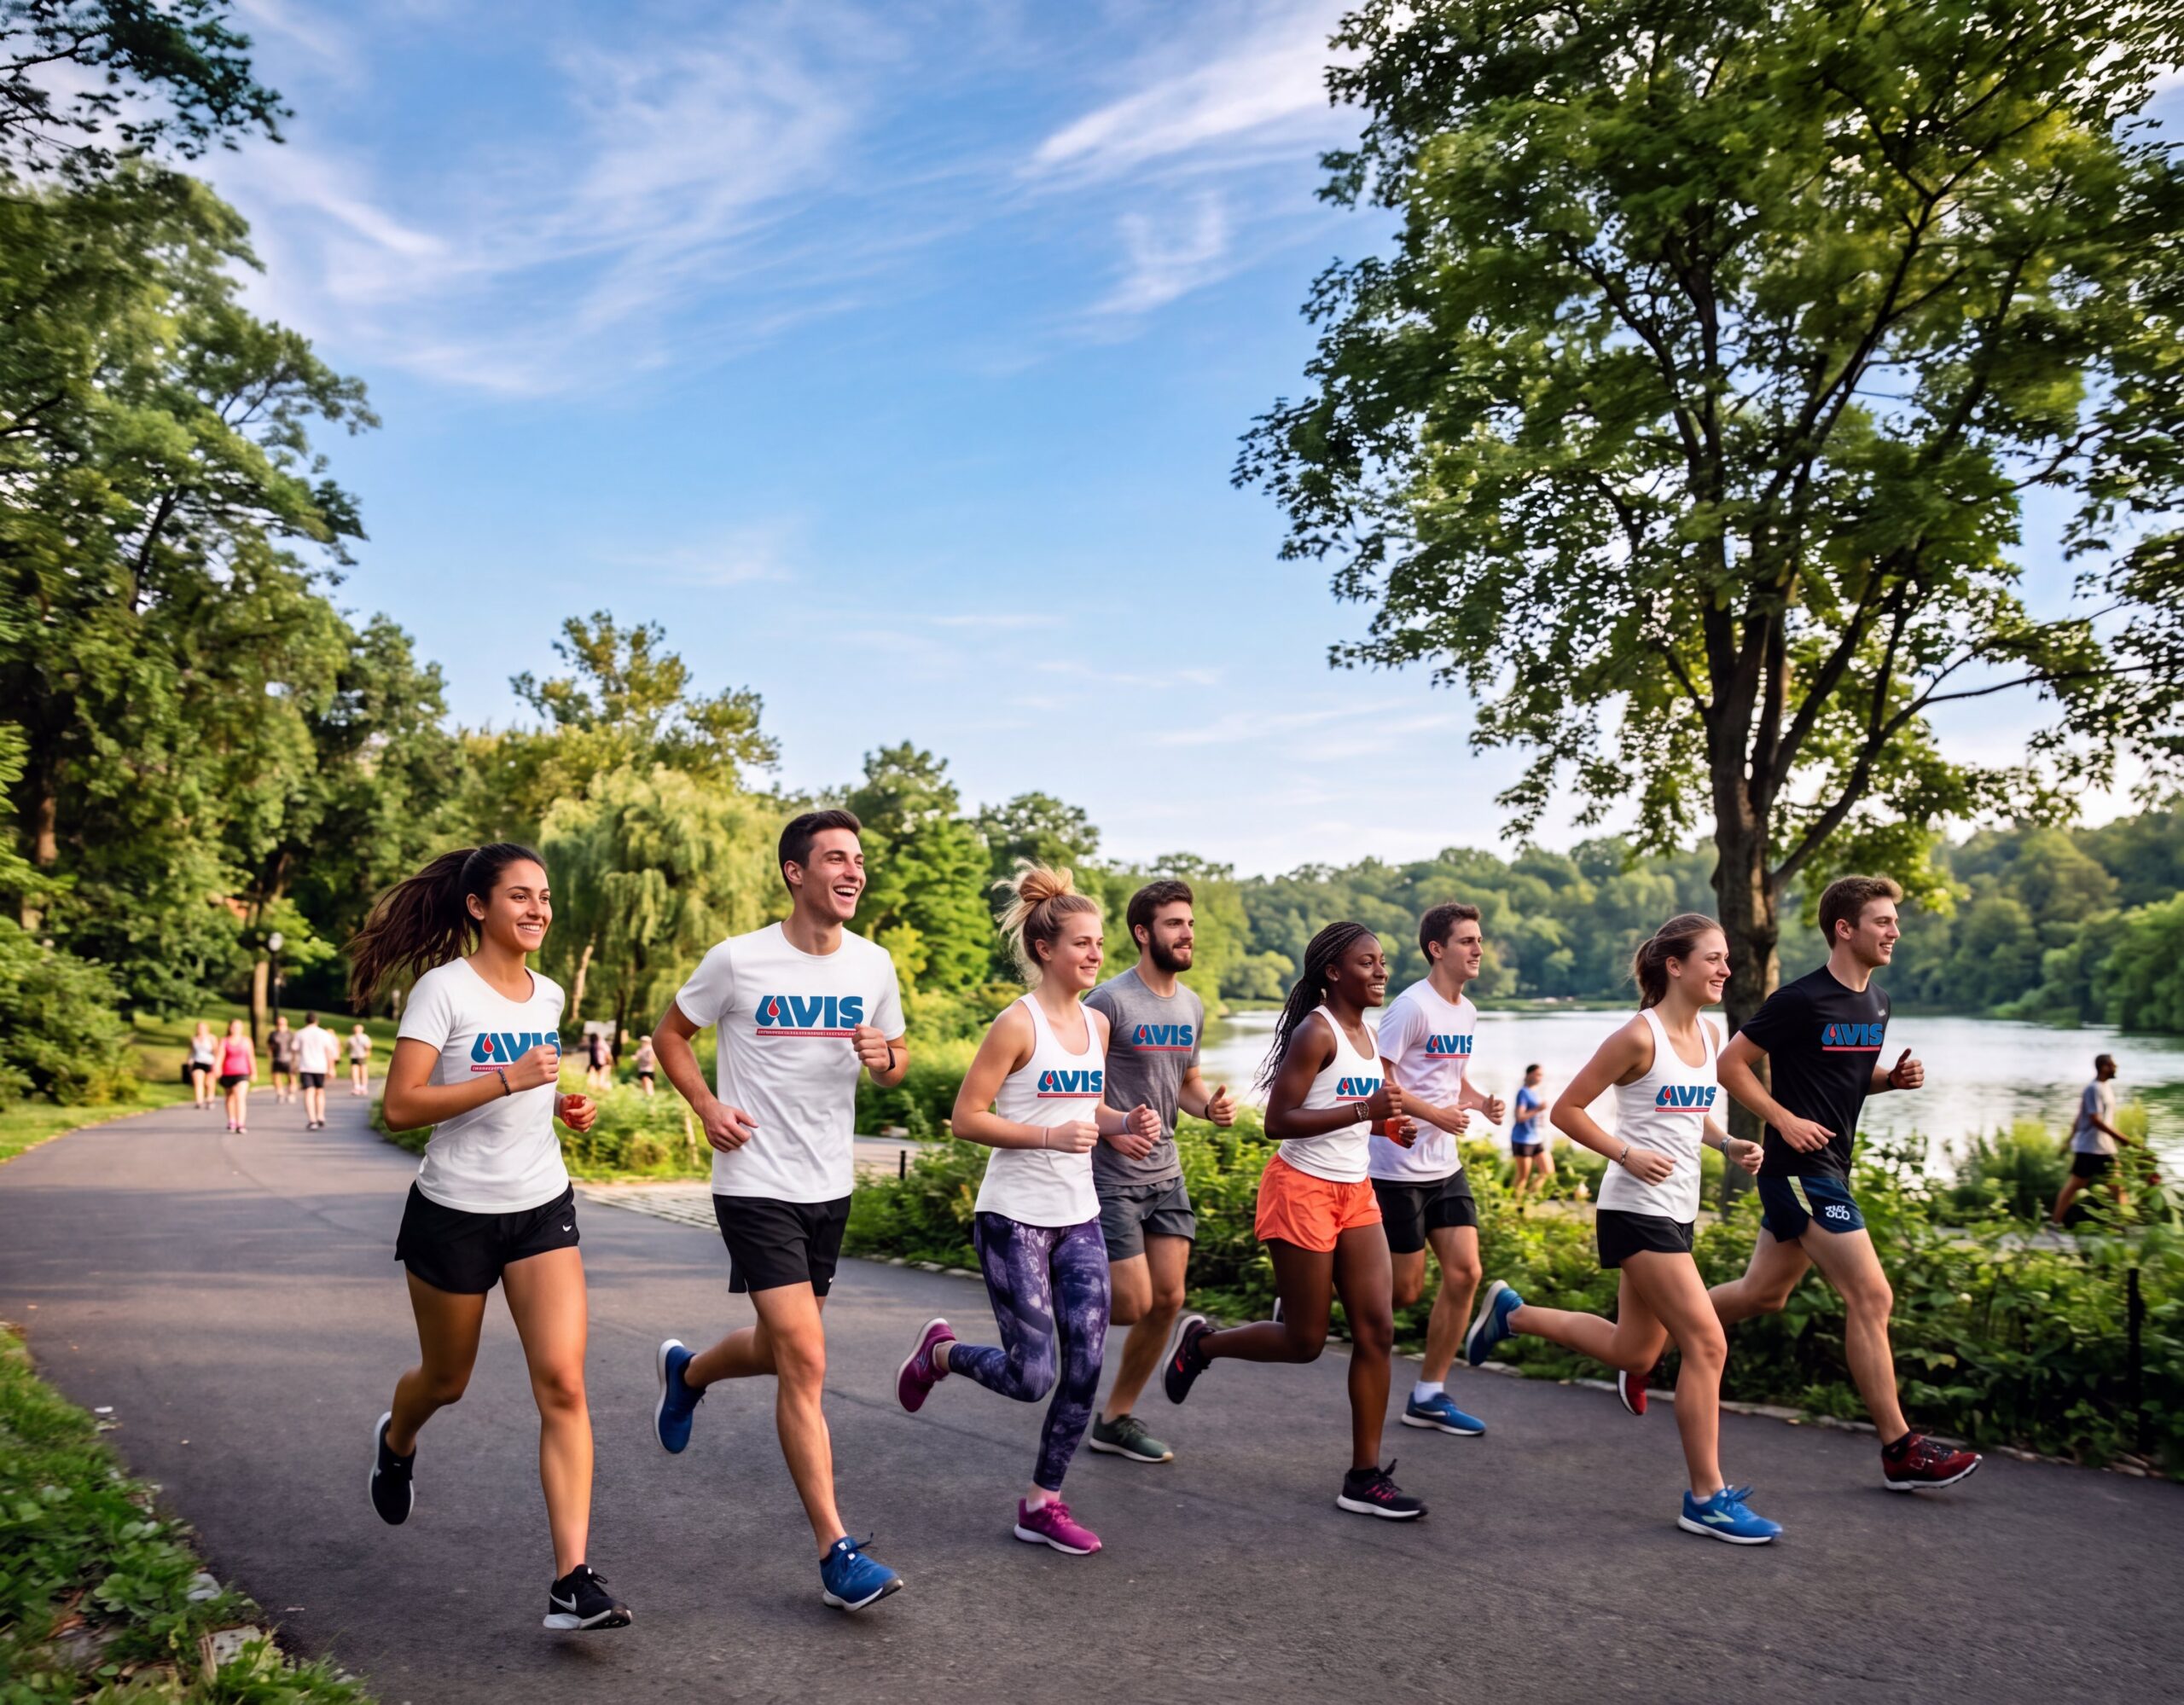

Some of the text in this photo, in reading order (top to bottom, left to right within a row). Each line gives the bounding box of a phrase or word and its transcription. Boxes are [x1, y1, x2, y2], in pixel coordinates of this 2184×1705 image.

[755, 995, 863, 1029] AVIS
[1132, 1024, 1193, 1046] AVIS
[1821, 1024, 1883, 1046] AVIS
[1037, 1070, 1102, 1092] AVIS
[1336, 1077, 1385, 1096] AVI
[1656, 1086, 1716, 1106] AVIS
